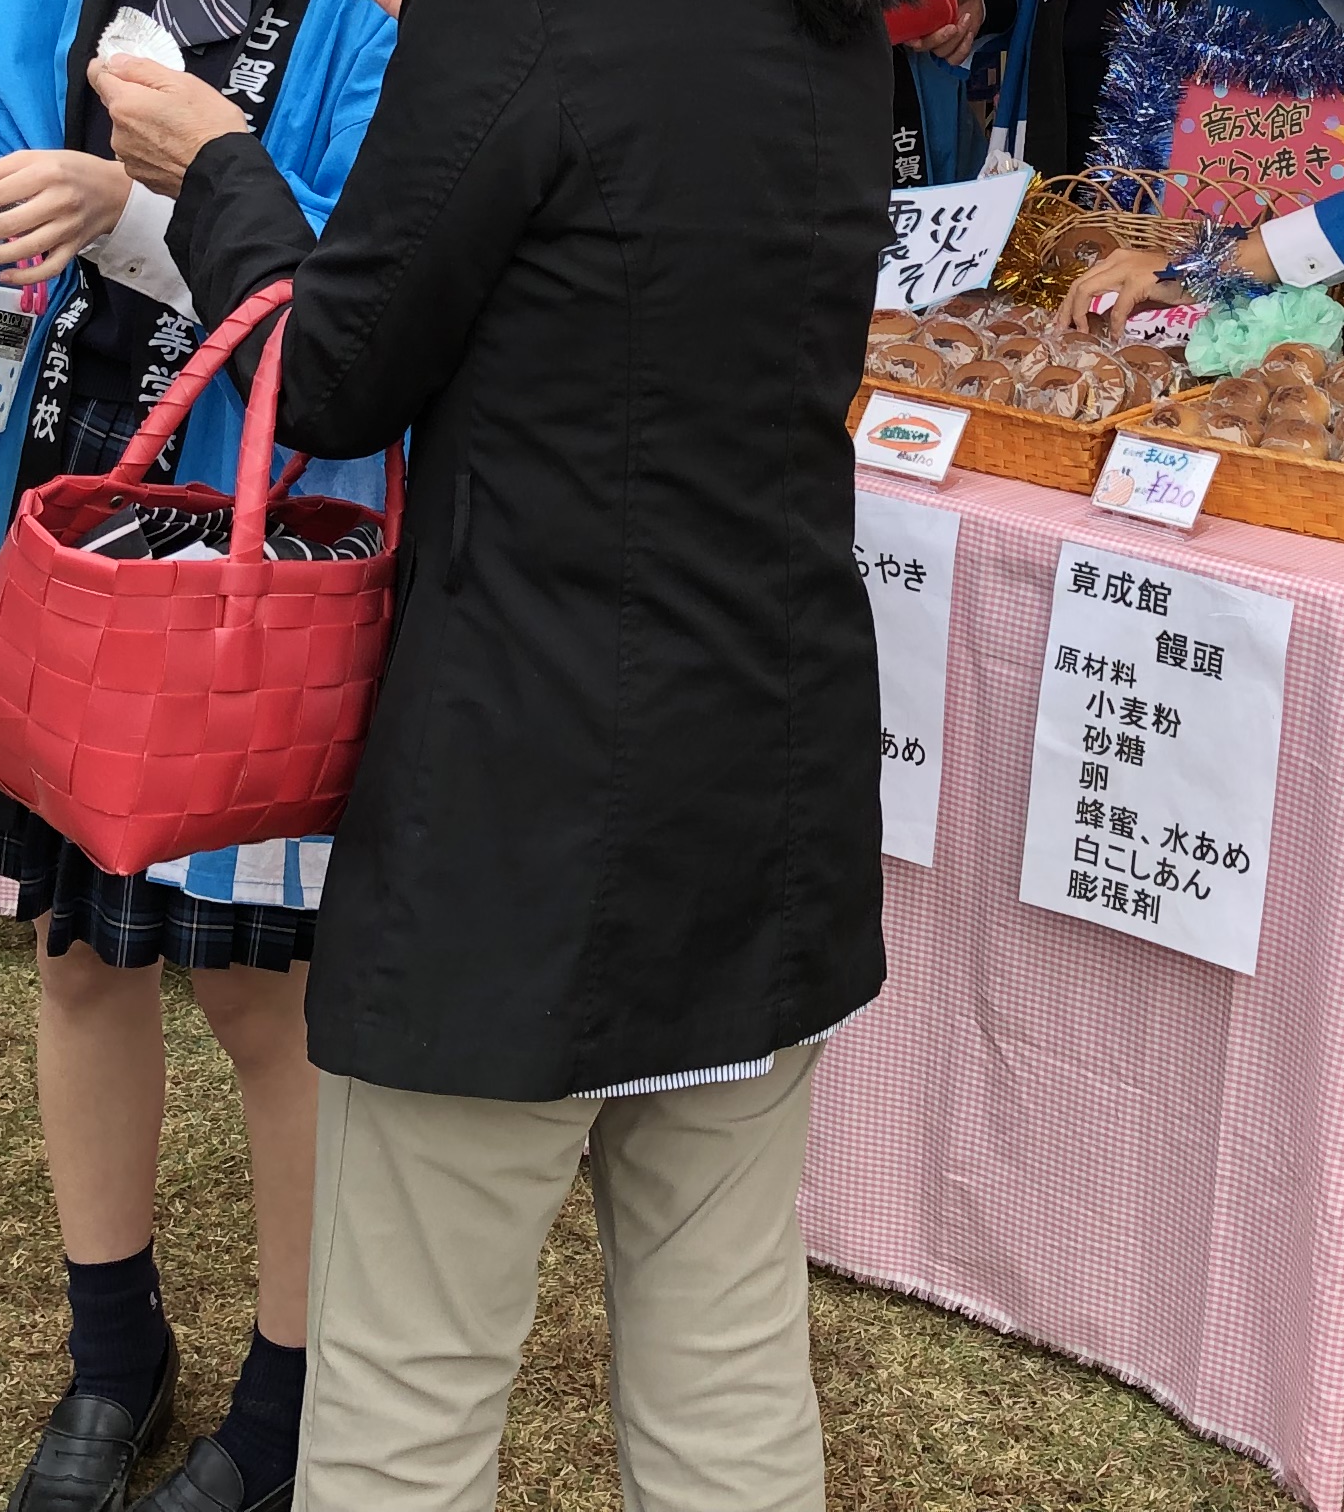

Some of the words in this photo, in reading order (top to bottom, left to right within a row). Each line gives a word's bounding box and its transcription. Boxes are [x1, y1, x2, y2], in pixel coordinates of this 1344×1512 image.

[221, 7, 290, 133] 古賀
[1201, 101, 1312, 147] 竟成館
[892, 126, 923, 187] 古賀
[1195, 143, 1332, 187] どら焼き
[897, 248, 989, 305] そば
[31, 267, 91, 444] 等学校
[1067, 561, 1172, 617] 竟成館
[1054, 644, 1138, 689] 原材料
[1155, 629, 1225, 682] 饅頭
[1085, 690, 1182, 739] 小麦粉
[880, 727, 926, 766] あめ
[1082, 724, 1146, 767] 砂糖
[1078, 761, 1110, 792] 卵
[1075, 797, 1251, 874] 蜂蜜、水あめ
[1073, 835, 1212, 901] 白こしあん
[1066, 870, 1162, 925] 膨張剤
